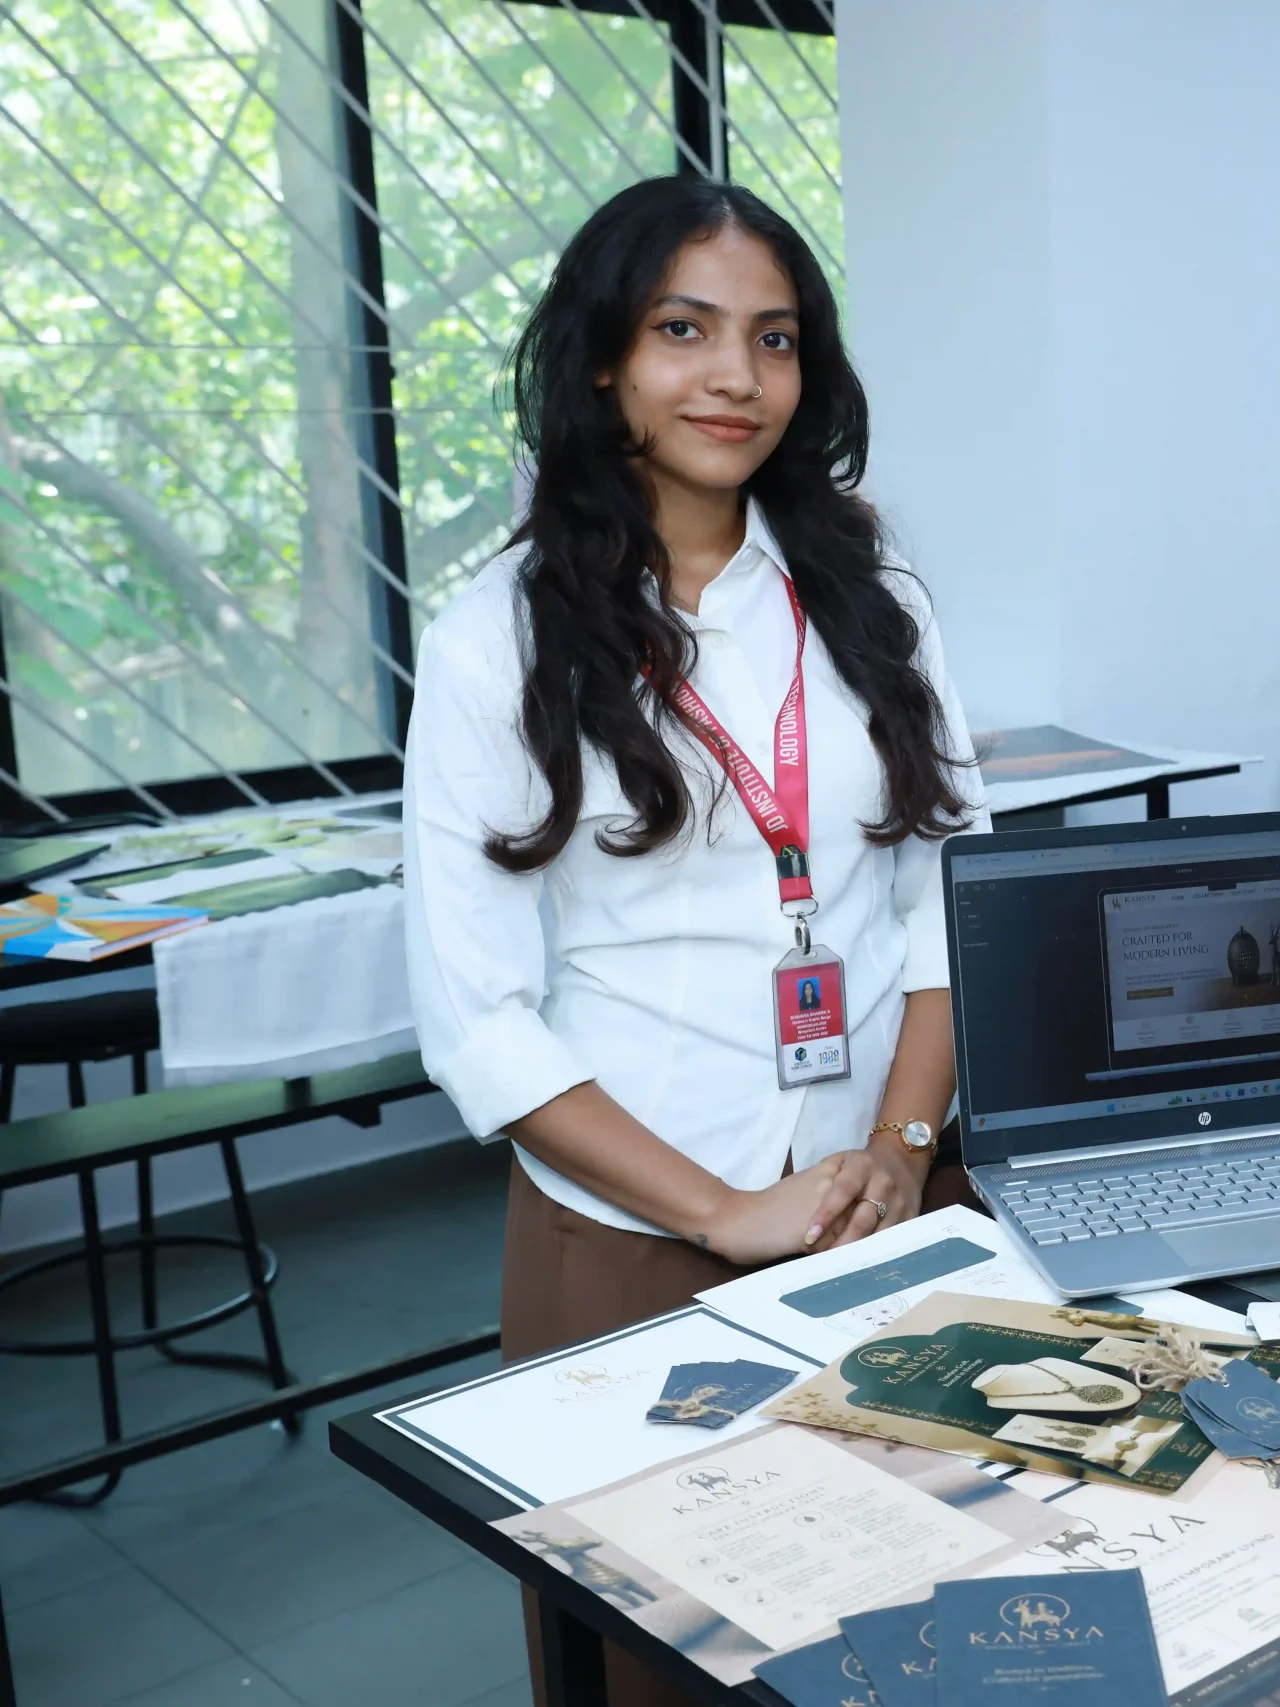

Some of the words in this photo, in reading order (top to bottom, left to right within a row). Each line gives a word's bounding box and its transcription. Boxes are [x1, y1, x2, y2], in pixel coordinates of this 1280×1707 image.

[779, 679, 800, 766] TECHNOLOGY
[727, 748, 776, 818] INSTITUTE
[765, 814, 789, 834] JD
[1124, 894, 1156, 904] KANSYA
[1122, 932, 1170, 948] CRAFTED
[1172, 931, 1193, 942] FOR
[1123, 947, 1170, 962] MODERN
[1173, 944, 1209, 957] LIVING
[819, 1050, 839, 1065] 1988
[1198, 1112, 1212, 1126] hp
[882, 1343, 948, 1385] KANSYA
[672, 1470, 781, 1515] KANSYA
[698, 1523, 734, 1539] CARE
[734, 1486, 825, 1526] INSTRUCTIONS
[1149, 1549, 1239, 1596] CONTEMPORARY
[1239, 1533, 1275, 1552] LIVING
[969, 1625, 1105, 1645] KANSYA
